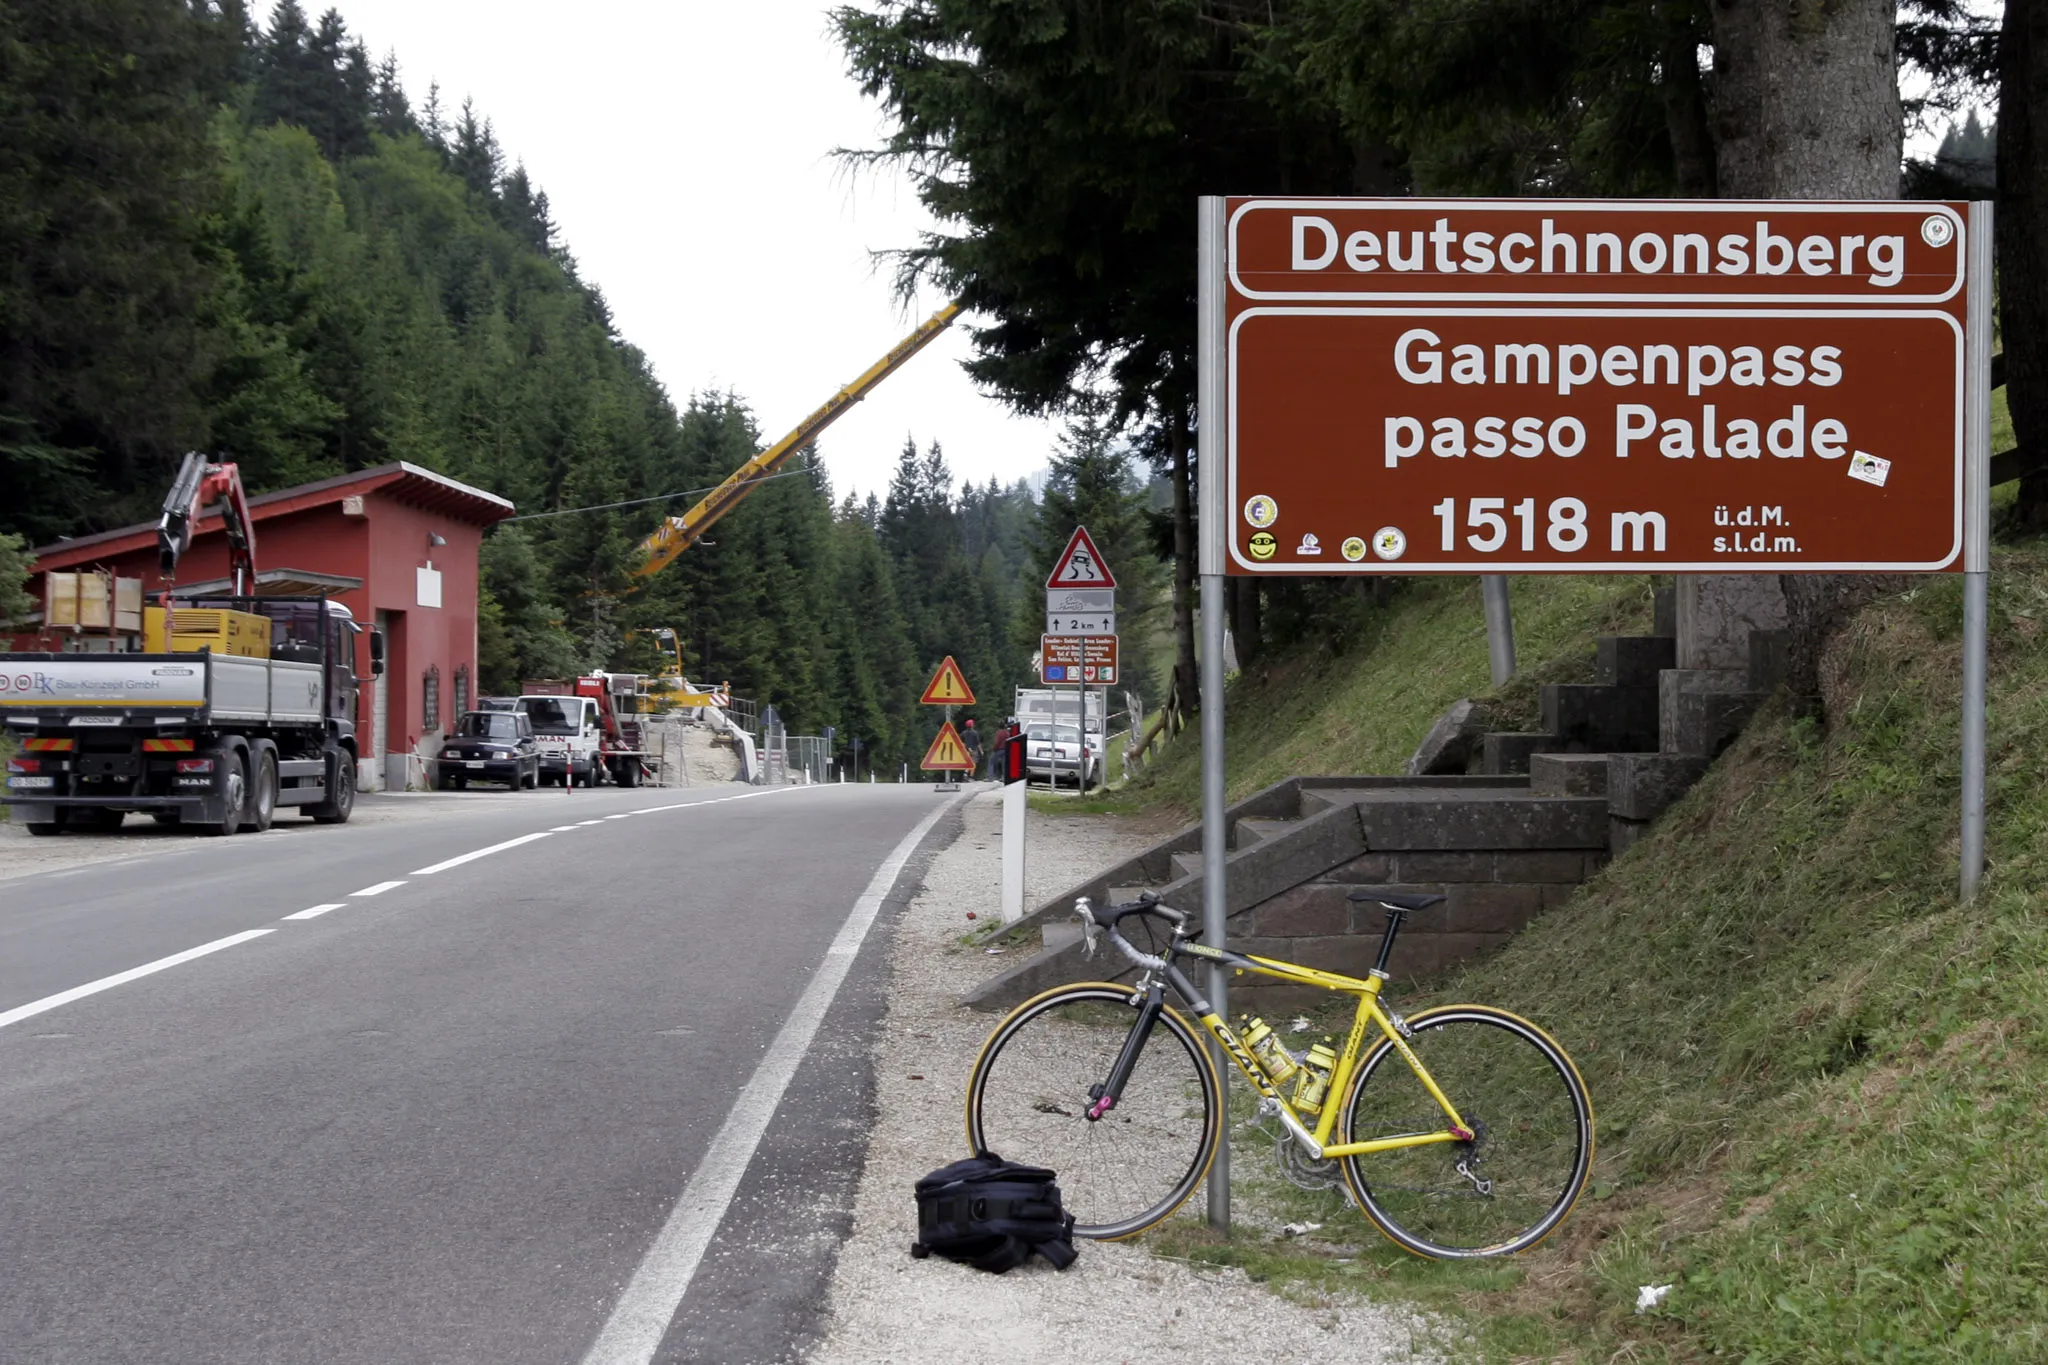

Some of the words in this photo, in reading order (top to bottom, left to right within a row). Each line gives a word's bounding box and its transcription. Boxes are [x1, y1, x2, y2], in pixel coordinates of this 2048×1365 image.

[1291, 215, 1905, 287] Deutschnonsberg
[1393, 328, 1843, 396] Gampenpass
[1384, 415, 1587, 468] passo
[1616, 403, 1848, 459] Palade
[1433, 496, 1589, 553] 1518
[1610, 511, 1666, 552] m
[1713, 505, 1791, 527] ü.d.M.
[1713, 531, 1802, 553] s.l.d.m.
[1071, 619, 1079, 630] 2
[1081, 622, 1094, 630] km
[126, 680, 160, 689] GmbH
[179, 778, 212, 786] MAN
[1347, 1022, 1362, 1060] GIANT
[1395, 1038, 1424, 1073] GIANT
